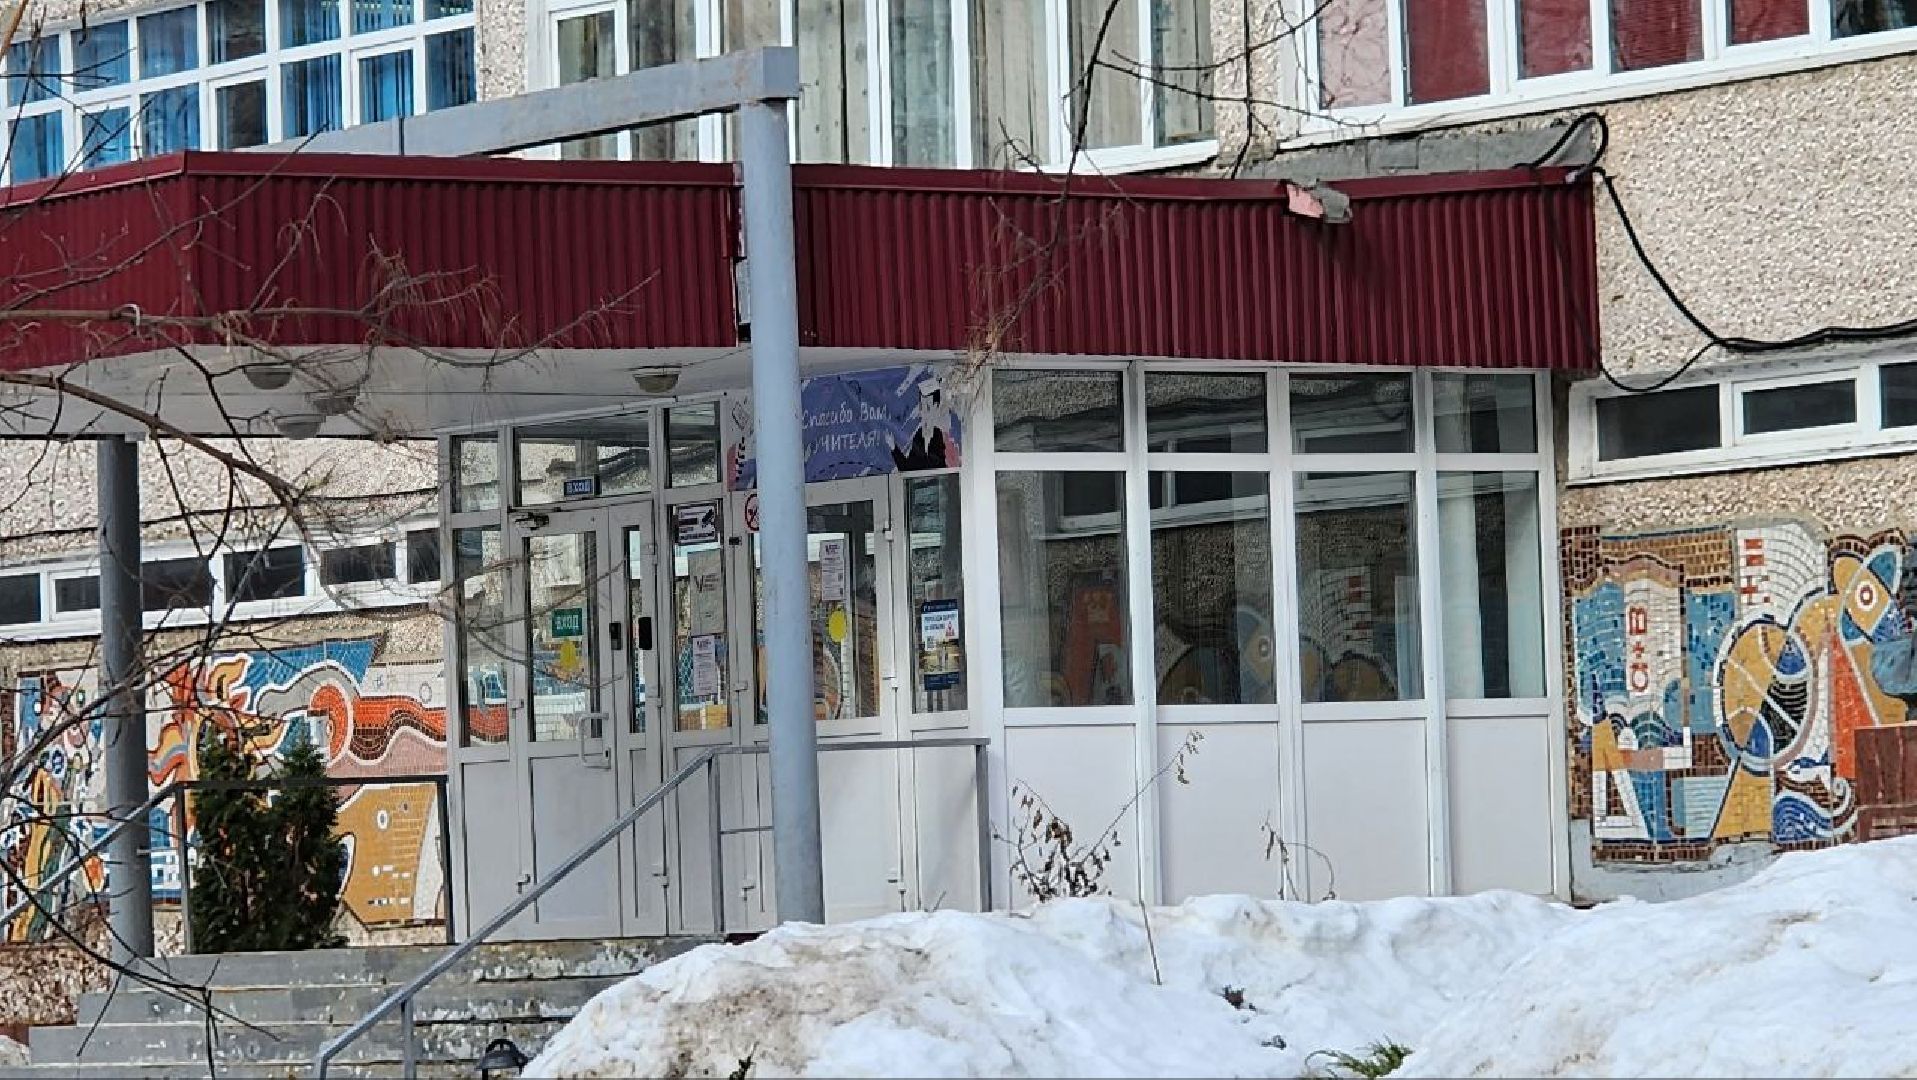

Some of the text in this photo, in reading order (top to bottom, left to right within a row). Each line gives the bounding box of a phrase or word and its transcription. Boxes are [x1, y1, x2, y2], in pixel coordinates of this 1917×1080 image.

[802, 401, 853, 430] Спасибо
[566, 482, 591, 494] ВХОД
[555, 614, 579, 630] ВХОД
